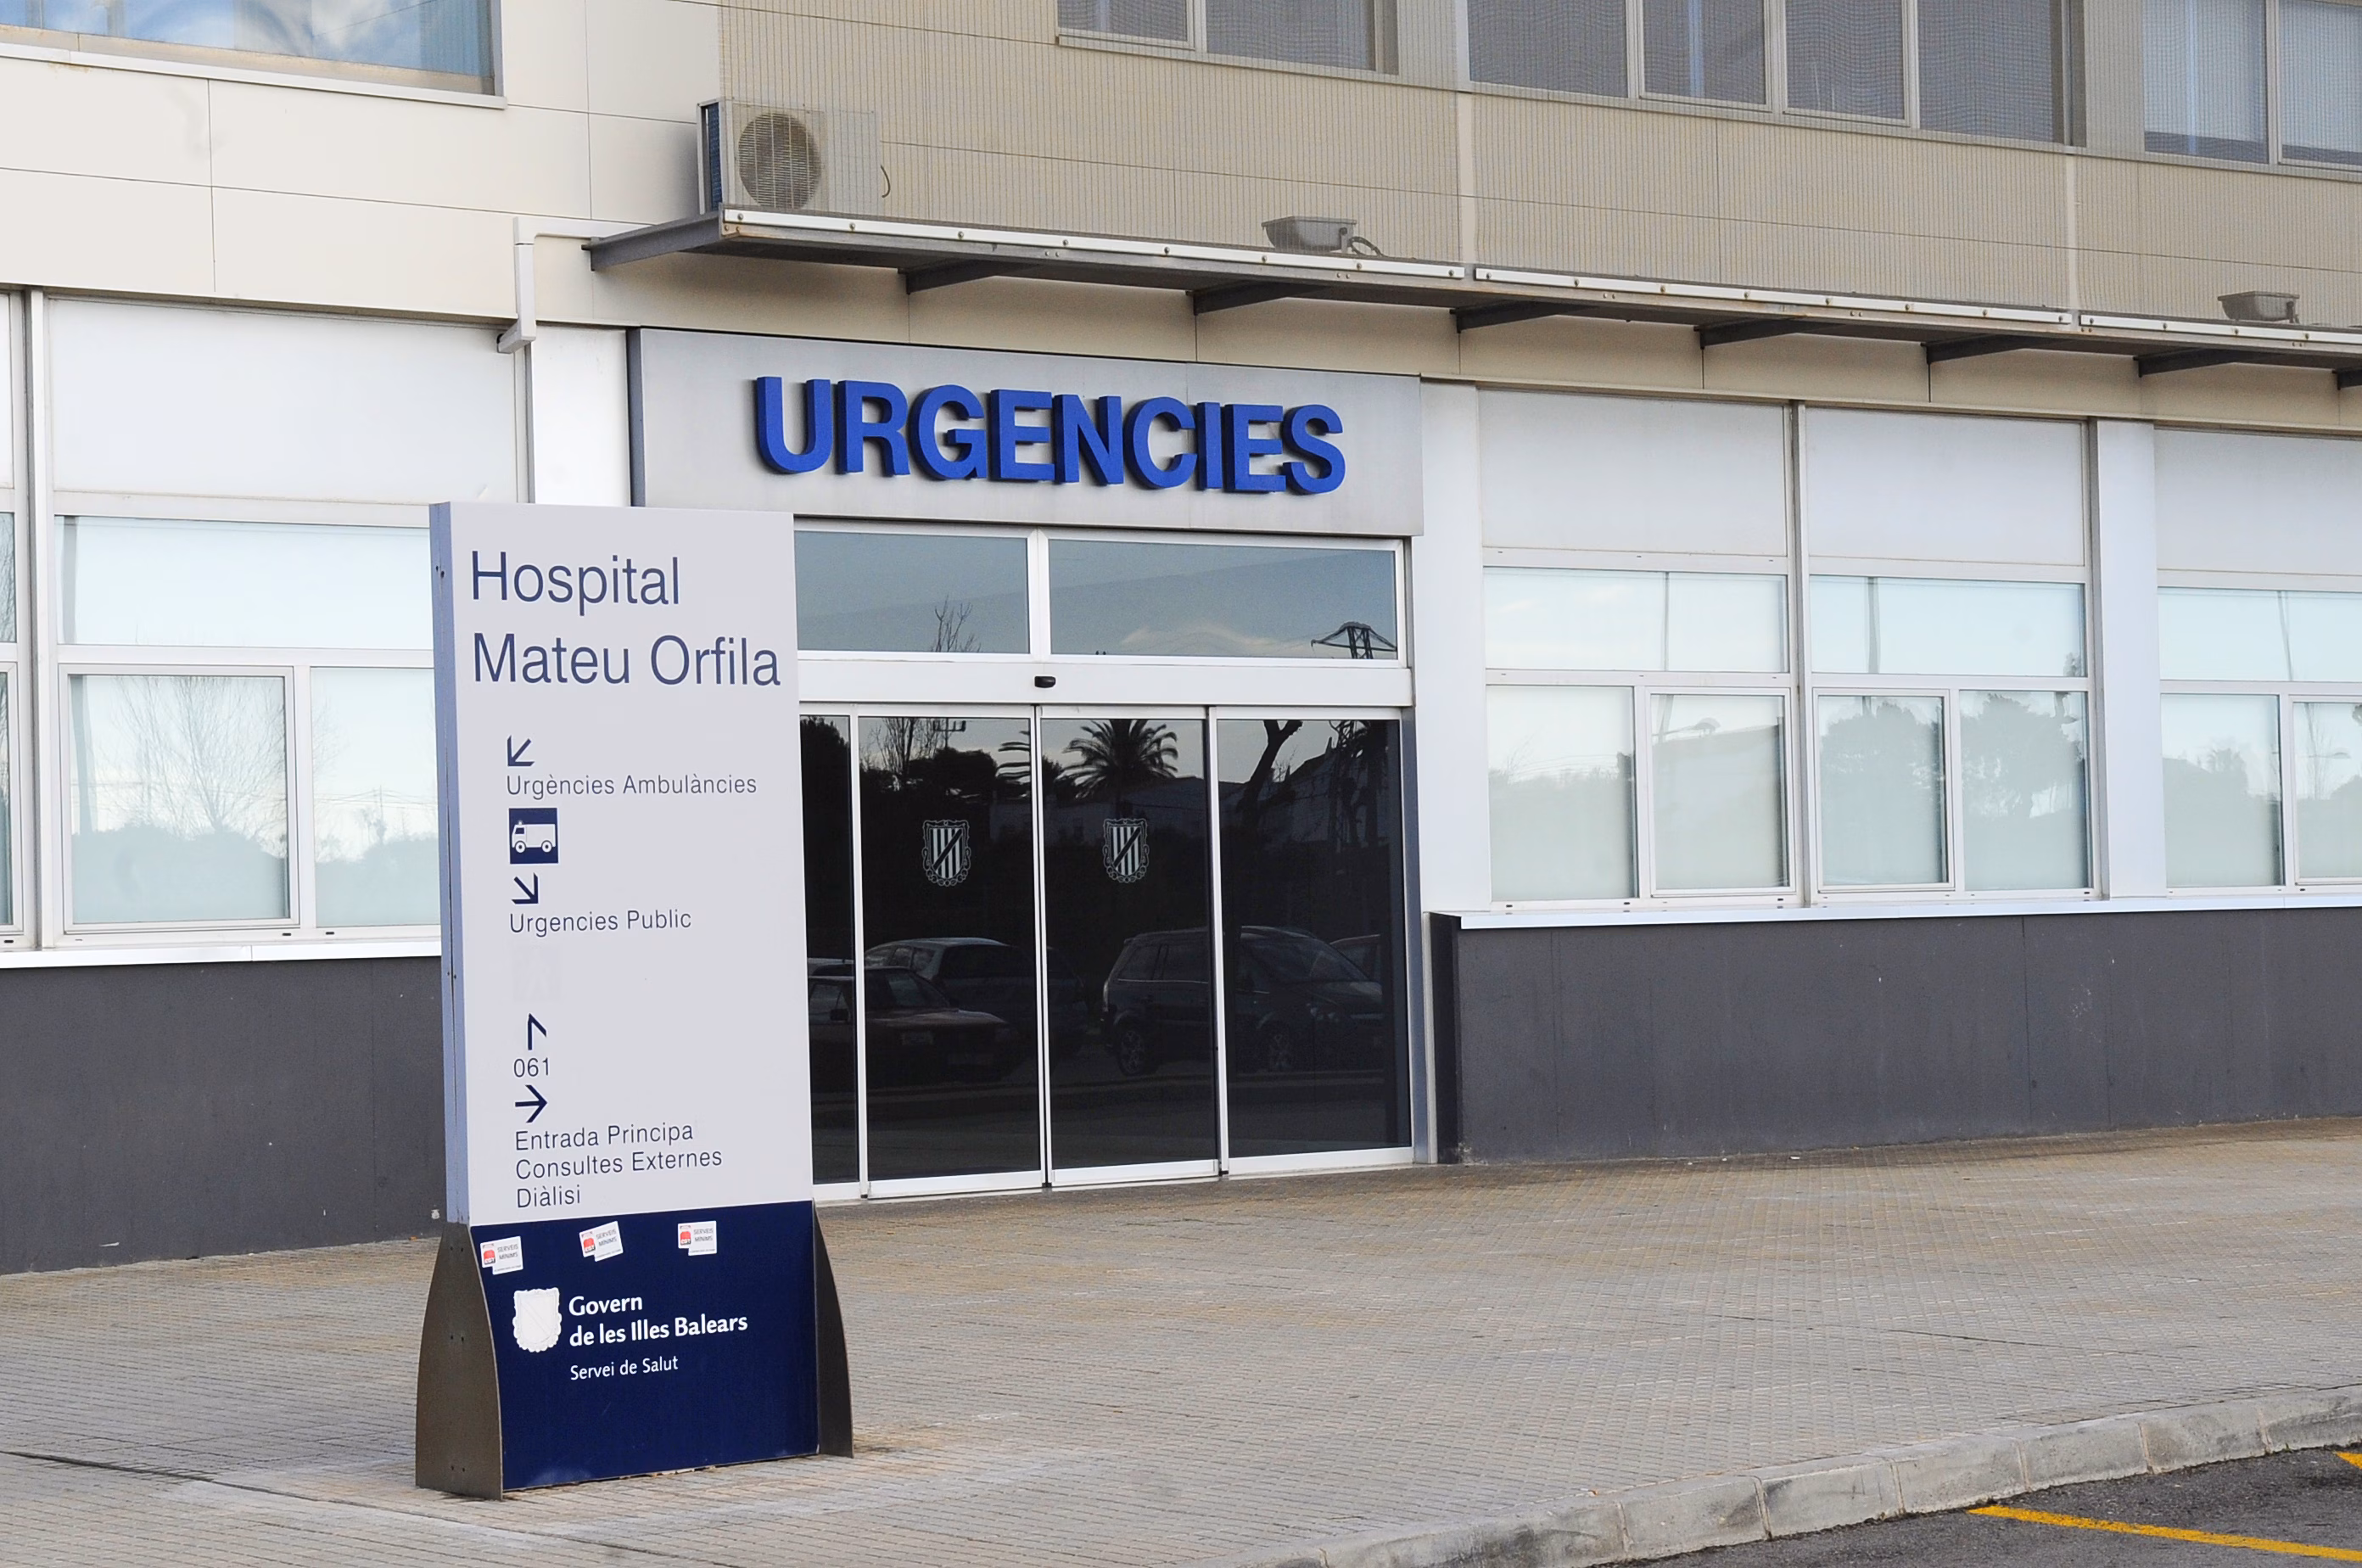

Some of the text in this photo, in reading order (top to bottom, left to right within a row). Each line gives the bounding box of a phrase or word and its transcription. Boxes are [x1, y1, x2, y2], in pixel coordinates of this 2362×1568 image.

[756, 375, 1346, 496] URGENCIES
[472, 550, 679, 617] Hospital
[473, 632, 781, 686] Mateu Orfila
[507, 773, 757, 800] Urgències Ambulàncies
[510, 909, 691, 938] Urgencies Public
[513, 1056, 550, 1078] 061
[515, 1122, 693, 1151] Entrada Principa
[516, 1151, 722, 1180] Consultes Externes
[517, 1184, 580, 1208] Diàlisi
[568, 1296, 643, 1317] Govern
[569, 1313, 748, 1347] de les Illes Balears
[570, 1355, 679, 1380] Servei de Salut
